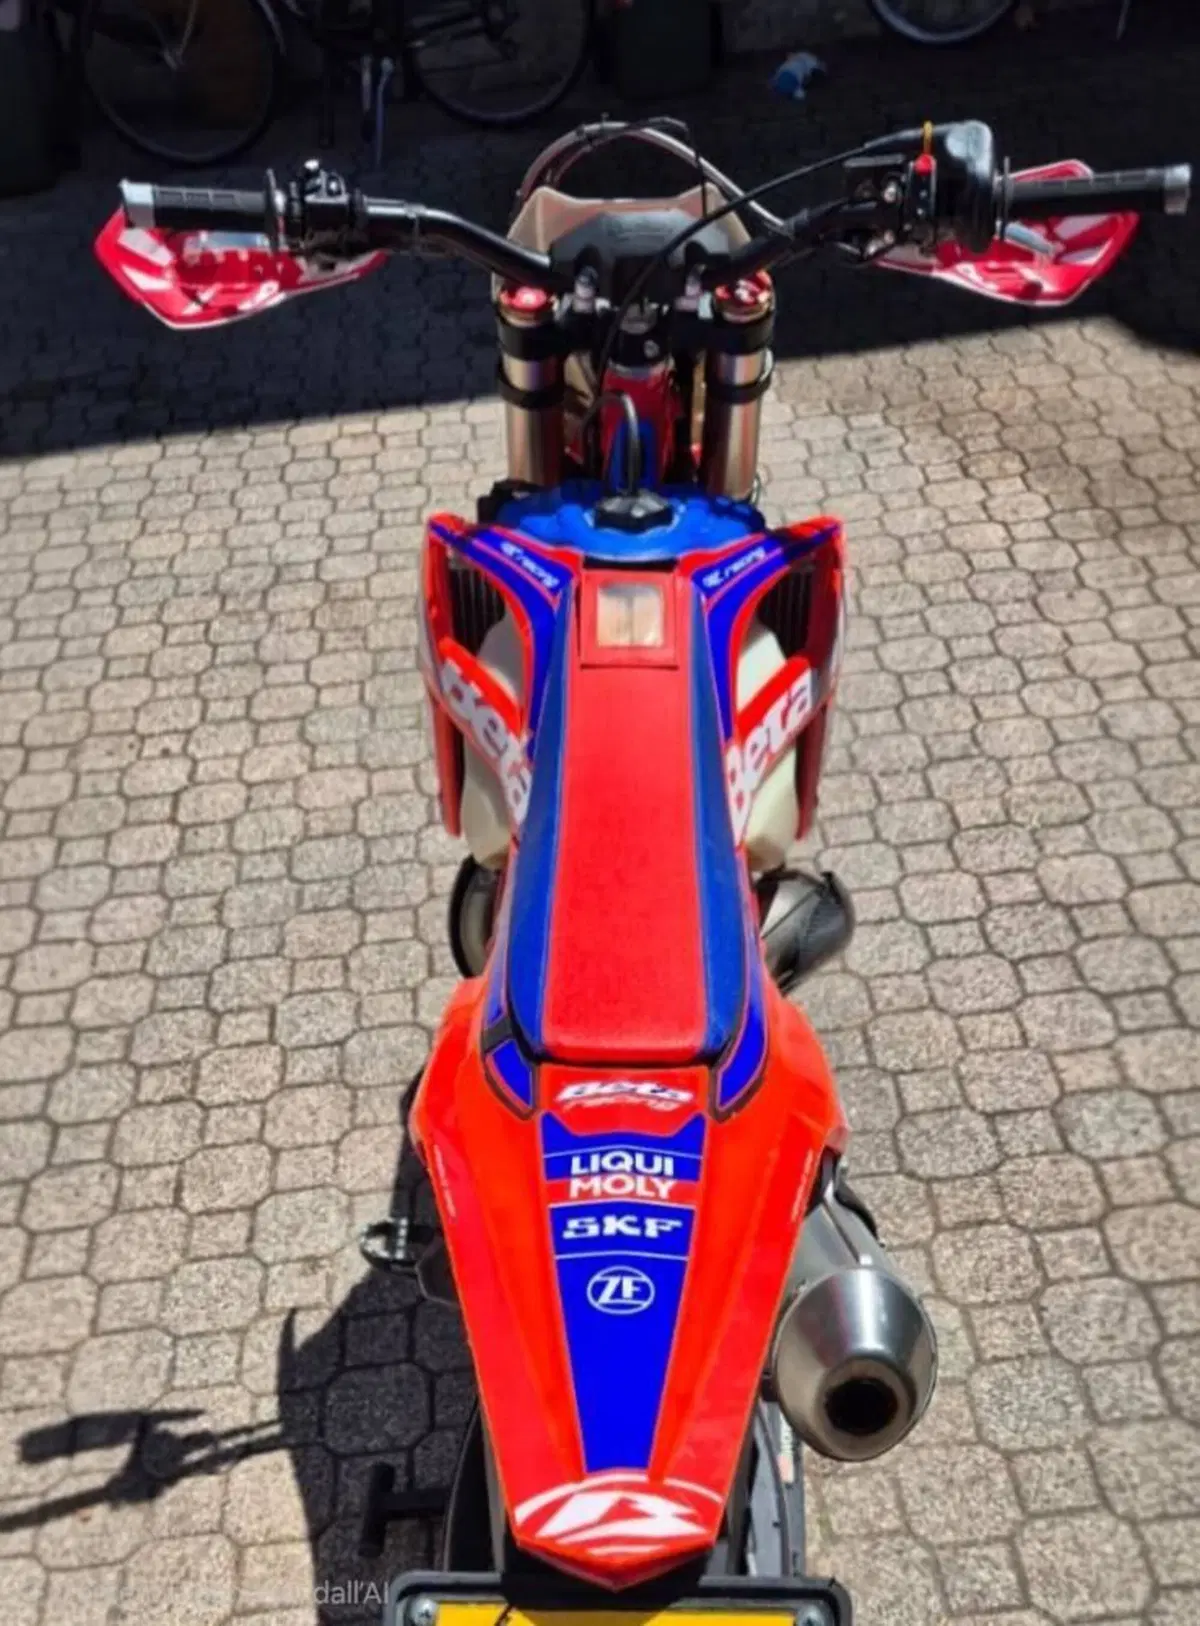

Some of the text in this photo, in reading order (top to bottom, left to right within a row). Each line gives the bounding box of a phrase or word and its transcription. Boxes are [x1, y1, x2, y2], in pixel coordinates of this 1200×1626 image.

[570, 1151, 675, 1176] LIQUI
[569, 1174, 677, 1199] MOLY
[562, 1214, 683, 1240] SKF
[598, 1275, 641, 1304] ZF
